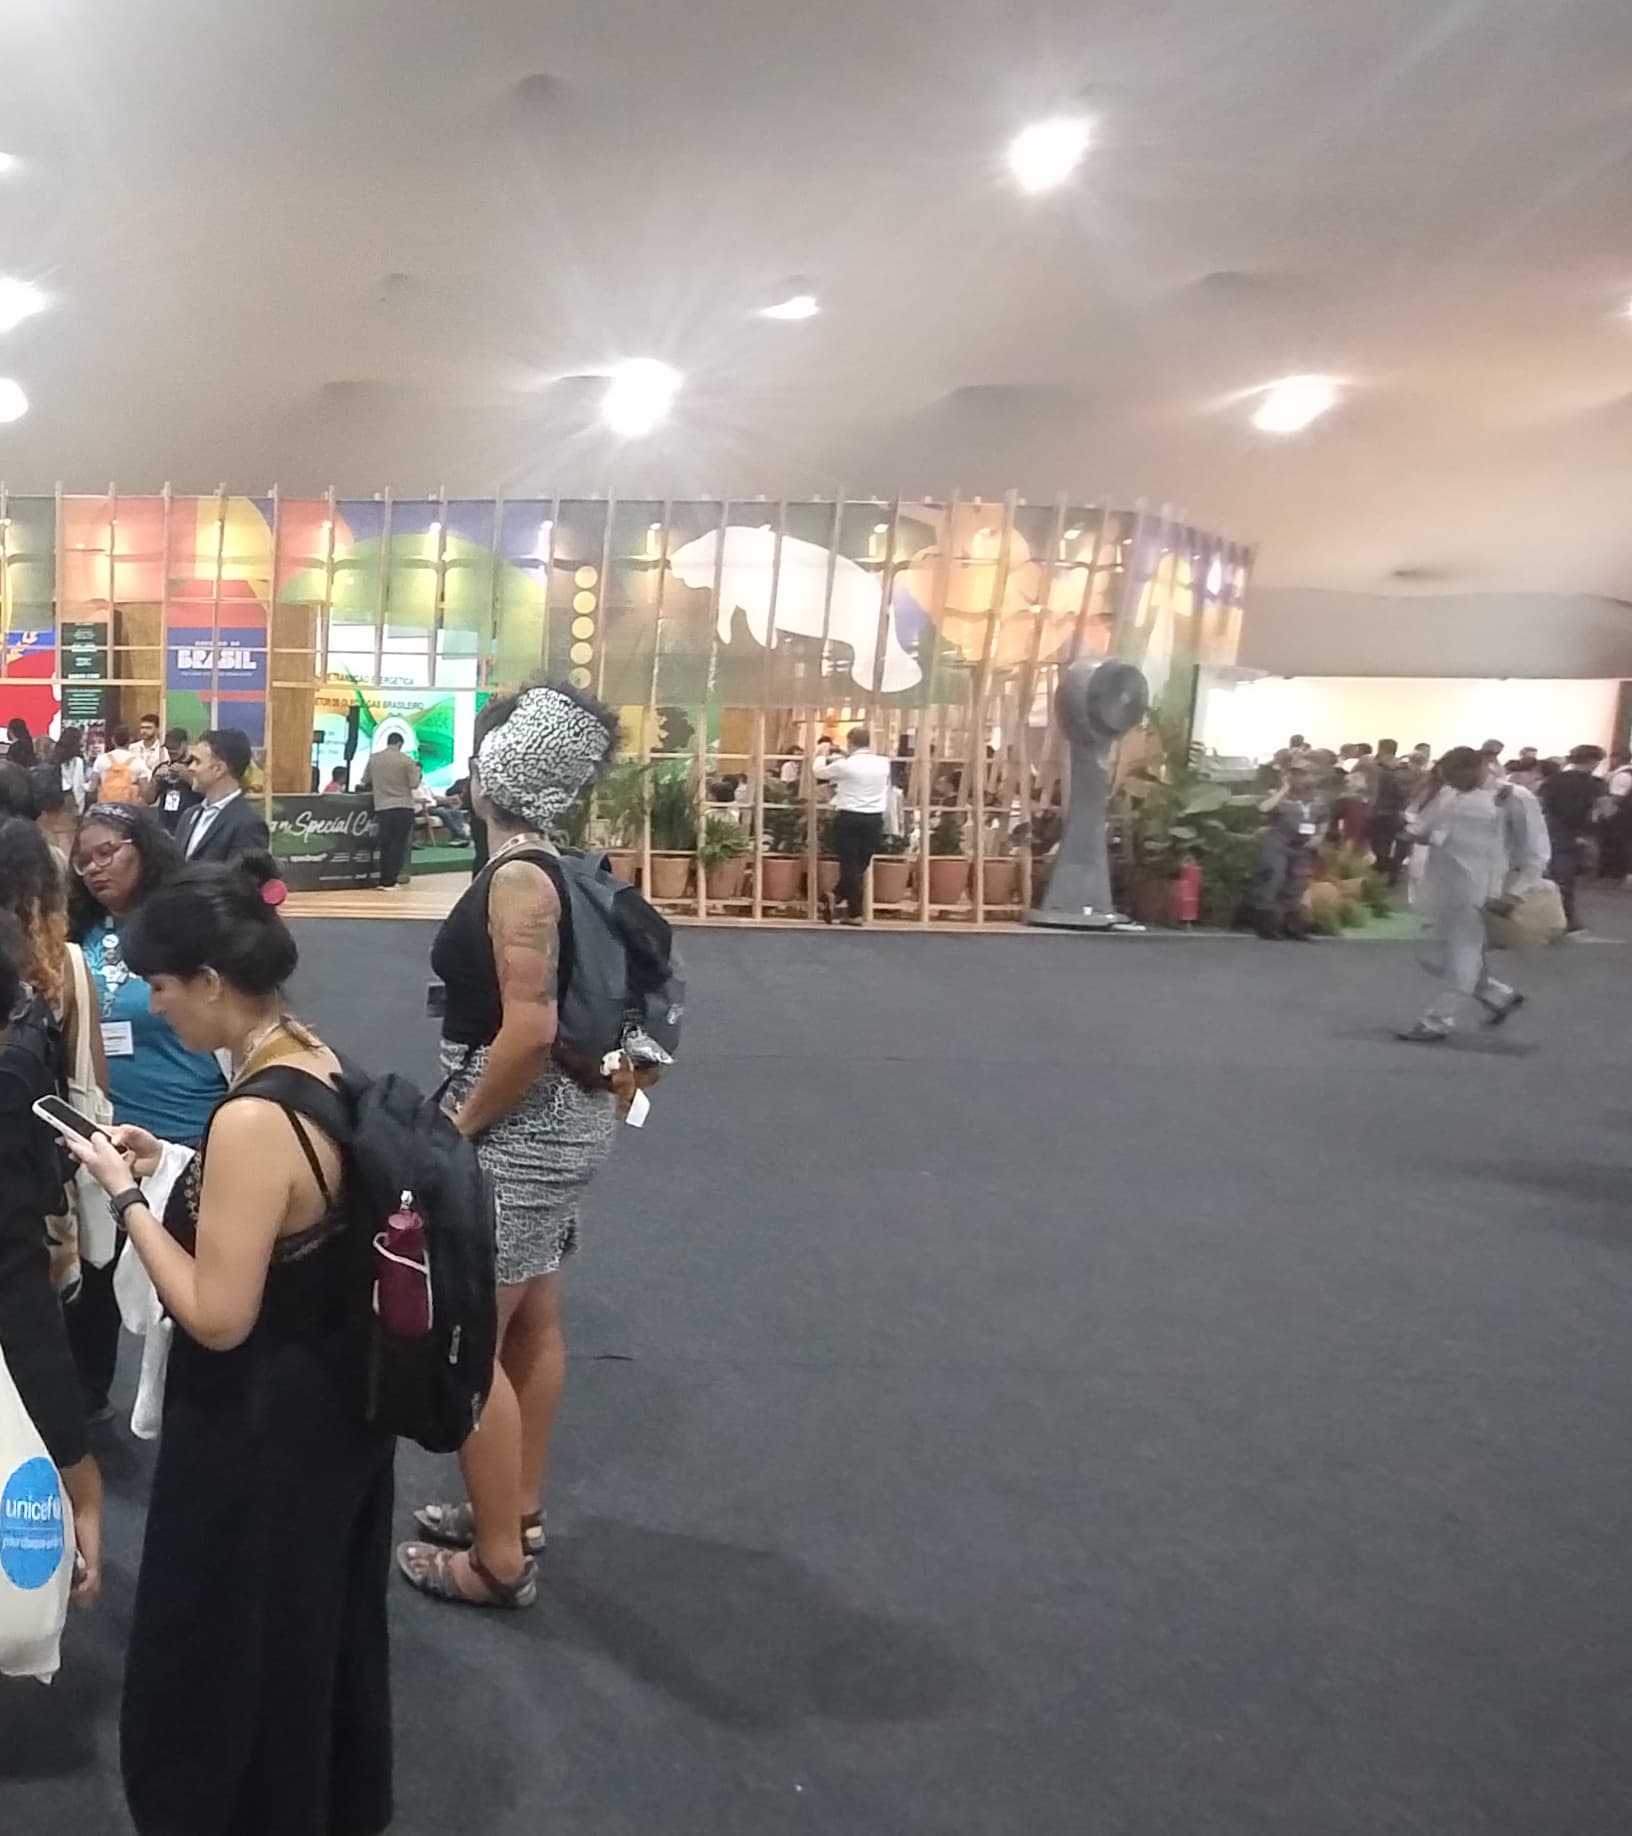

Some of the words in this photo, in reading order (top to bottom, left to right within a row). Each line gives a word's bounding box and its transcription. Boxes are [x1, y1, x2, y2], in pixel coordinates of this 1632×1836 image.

[177, 649, 257, 670] BRASIL
[289, 811, 354, 843] Special
[5, 1493, 54, 1521] unicef
